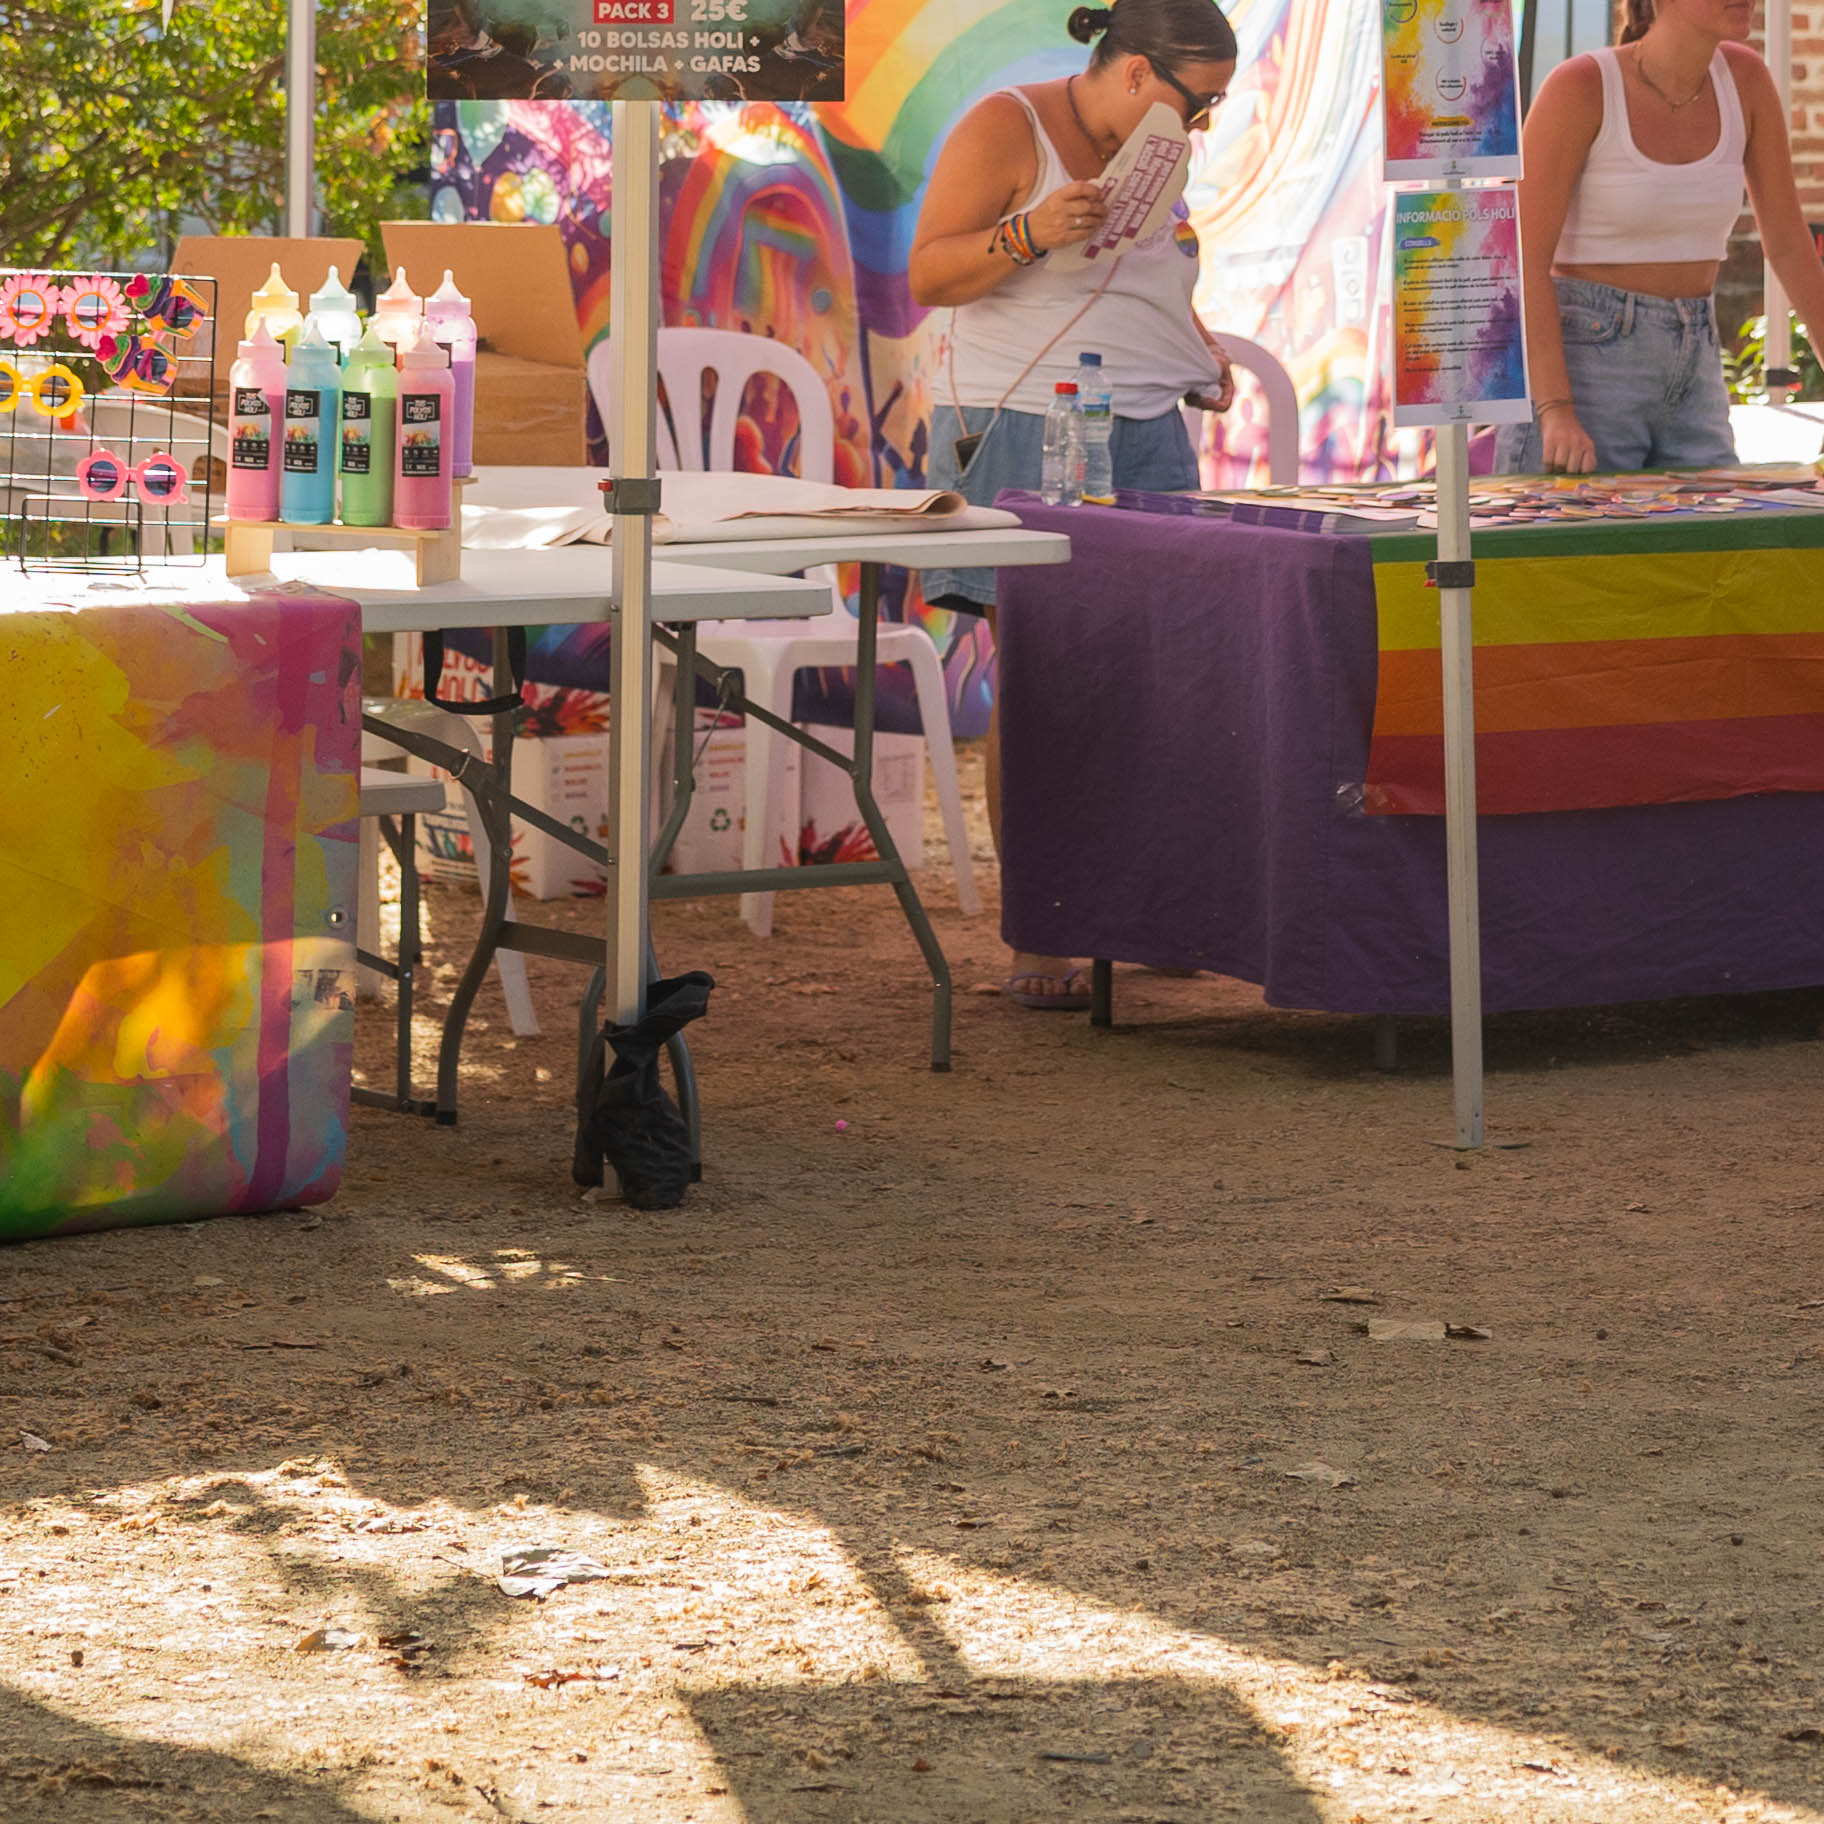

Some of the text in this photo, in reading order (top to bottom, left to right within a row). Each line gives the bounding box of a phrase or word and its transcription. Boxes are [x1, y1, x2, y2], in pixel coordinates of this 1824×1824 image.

[598, 2, 652, 19] PACK
[656, 3, 669, 19] 3
[577, 31, 601, 48] 10
[606, 31, 689, 48] BOLSAS
[694, 31, 743, 48] HOLI
[569, 56, 668, 73] MOCHILA
[689, 56, 761, 73] GAFAS
[1491, 207, 1516, 220] HOLI
